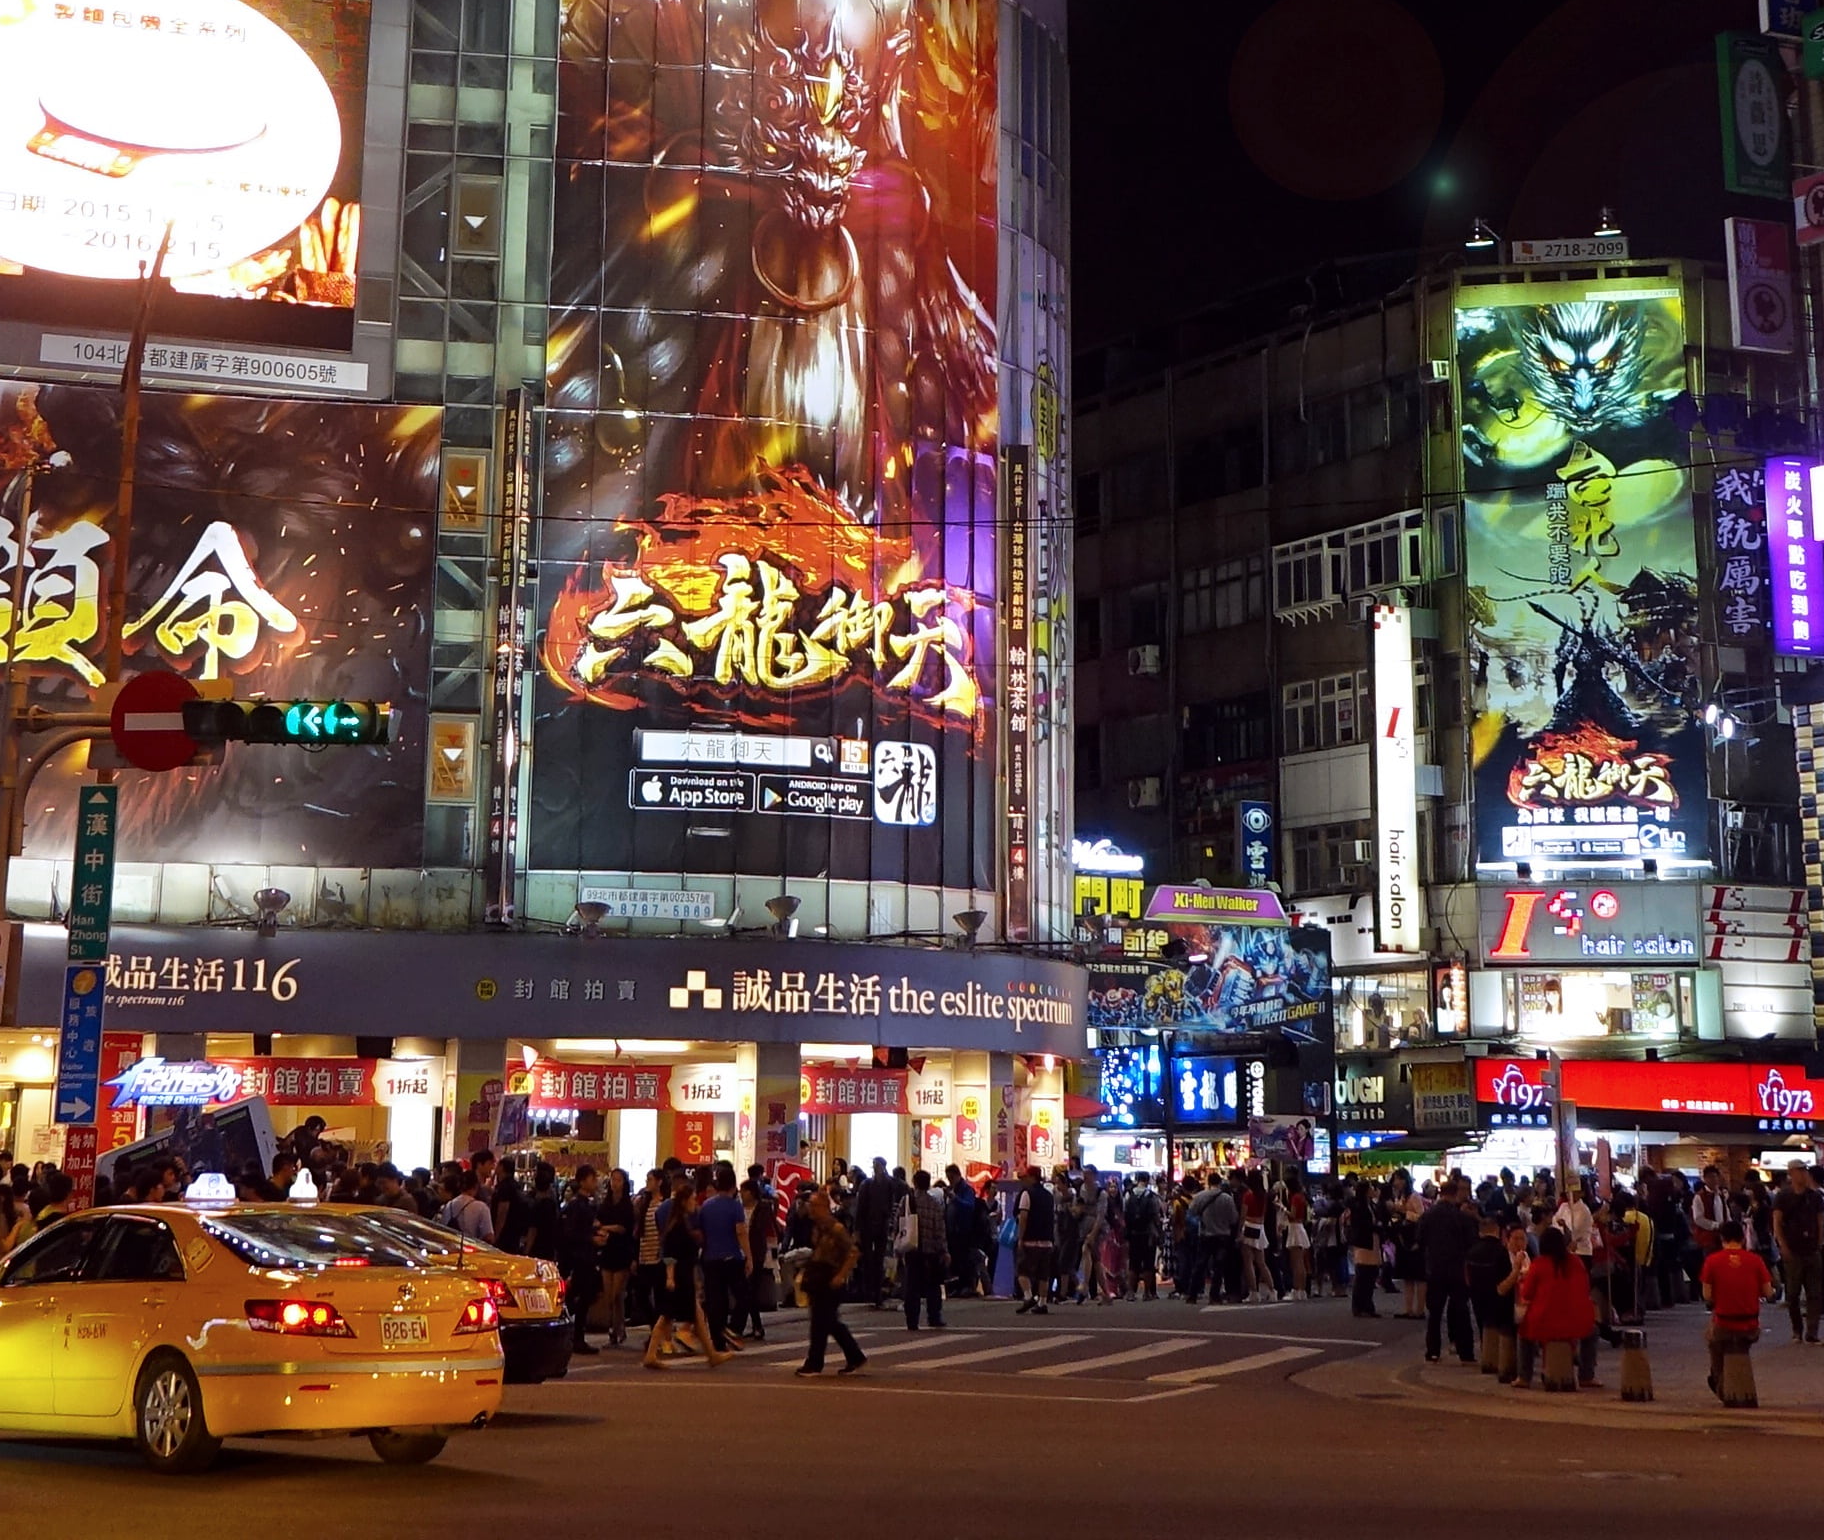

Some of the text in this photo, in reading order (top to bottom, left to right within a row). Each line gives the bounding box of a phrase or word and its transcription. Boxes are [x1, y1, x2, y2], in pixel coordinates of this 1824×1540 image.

[1544, 241, 1625, 257] 2718-2099
[1556, 440, 1623, 597] 台北人
[1784, 470, 1811, 641] 炭火單點吃到飽
[578, 554, 978, 720] 六龍御天
[1009, 645, 1027, 733] 翰林茶館
[680, 736, 773, 761] 六龍御天
[670, 776, 715, 787] Download
[716, 778, 729, 788] on
[789, 780, 827, 791] ANDROID
[845, 784, 858, 793] ON
[669, 787, 702, 806] App
[703, 787, 745, 805] Store
[838, 795, 864, 816] play
[78, 812, 111, 908] 漢中街
[1389, 828, 1407, 931] hair salon
[1074, 875, 1145, 920] 門町
[1173, 891, 1259, 913] Xi-Men Walker
[72, 914, 96, 926] Han
[70, 929, 107, 943] Zhong
[1580, 934, 1695, 956] hair salon
[115, 994, 186, 1008] spectrum 116
[514, 978, 637, 1002] 封館拍賣
[732, 968, 1074, 1033] 誠品生活 the eslite spectrum
[67, 997, 81, 1060] 服務中心
[241, 1065, 367, 1100] 封館拍賣
[385, 1077, 429, 1098] 1折起
[540, 1070, 661, 1102] 封館拍賣
[681, 1082, 723, 1102] 1折起
[815, 1076, 900, 1107] 封館拍賣
[915, 1089, 944, 1106] 1折起
[1772, 1088, 1814, 1117] i973
[688, 1134, 703, 1155] 3
[962, 1132, 981, 1152] 封
[382, 1320, 427, 1341] 826-EW
